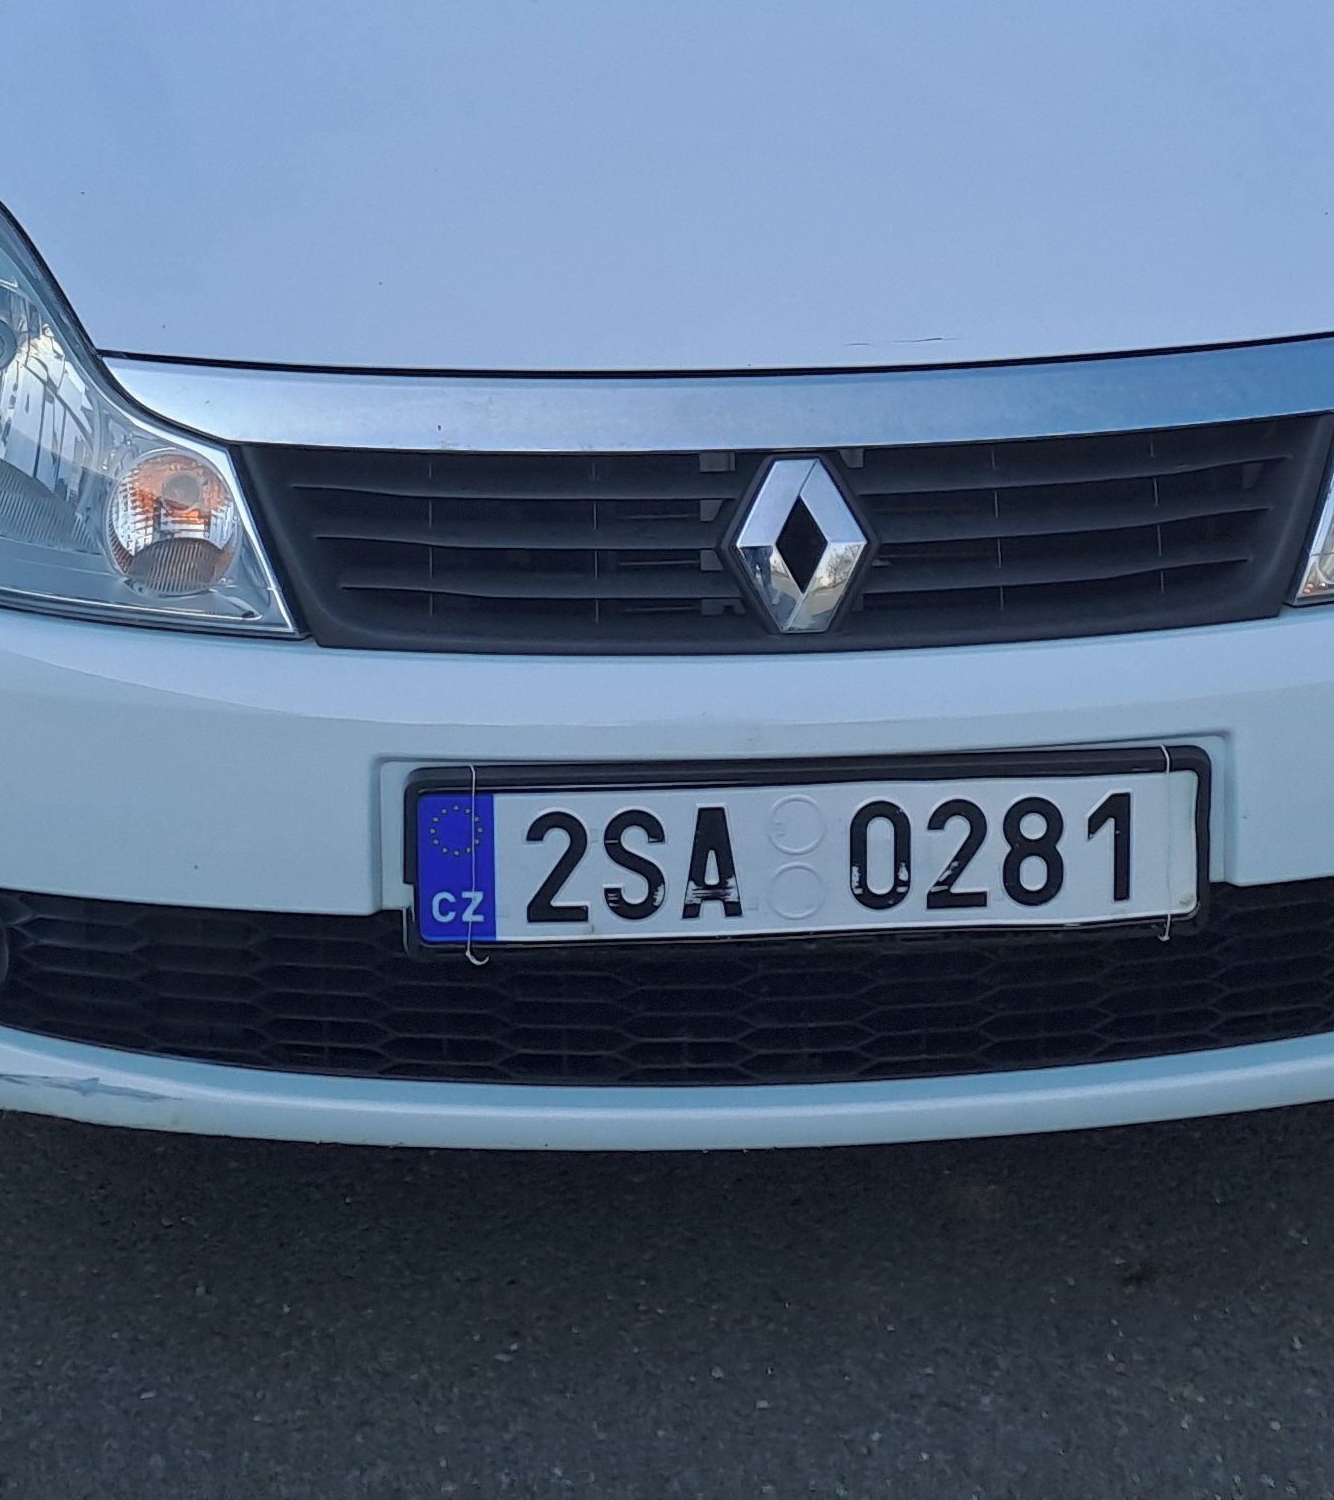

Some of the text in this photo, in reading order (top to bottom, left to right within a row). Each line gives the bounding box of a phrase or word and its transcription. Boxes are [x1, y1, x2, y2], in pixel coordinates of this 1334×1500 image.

[525, 792, 1131, 923] 2SA 0281
[432, 891, 485, 922] CZ
